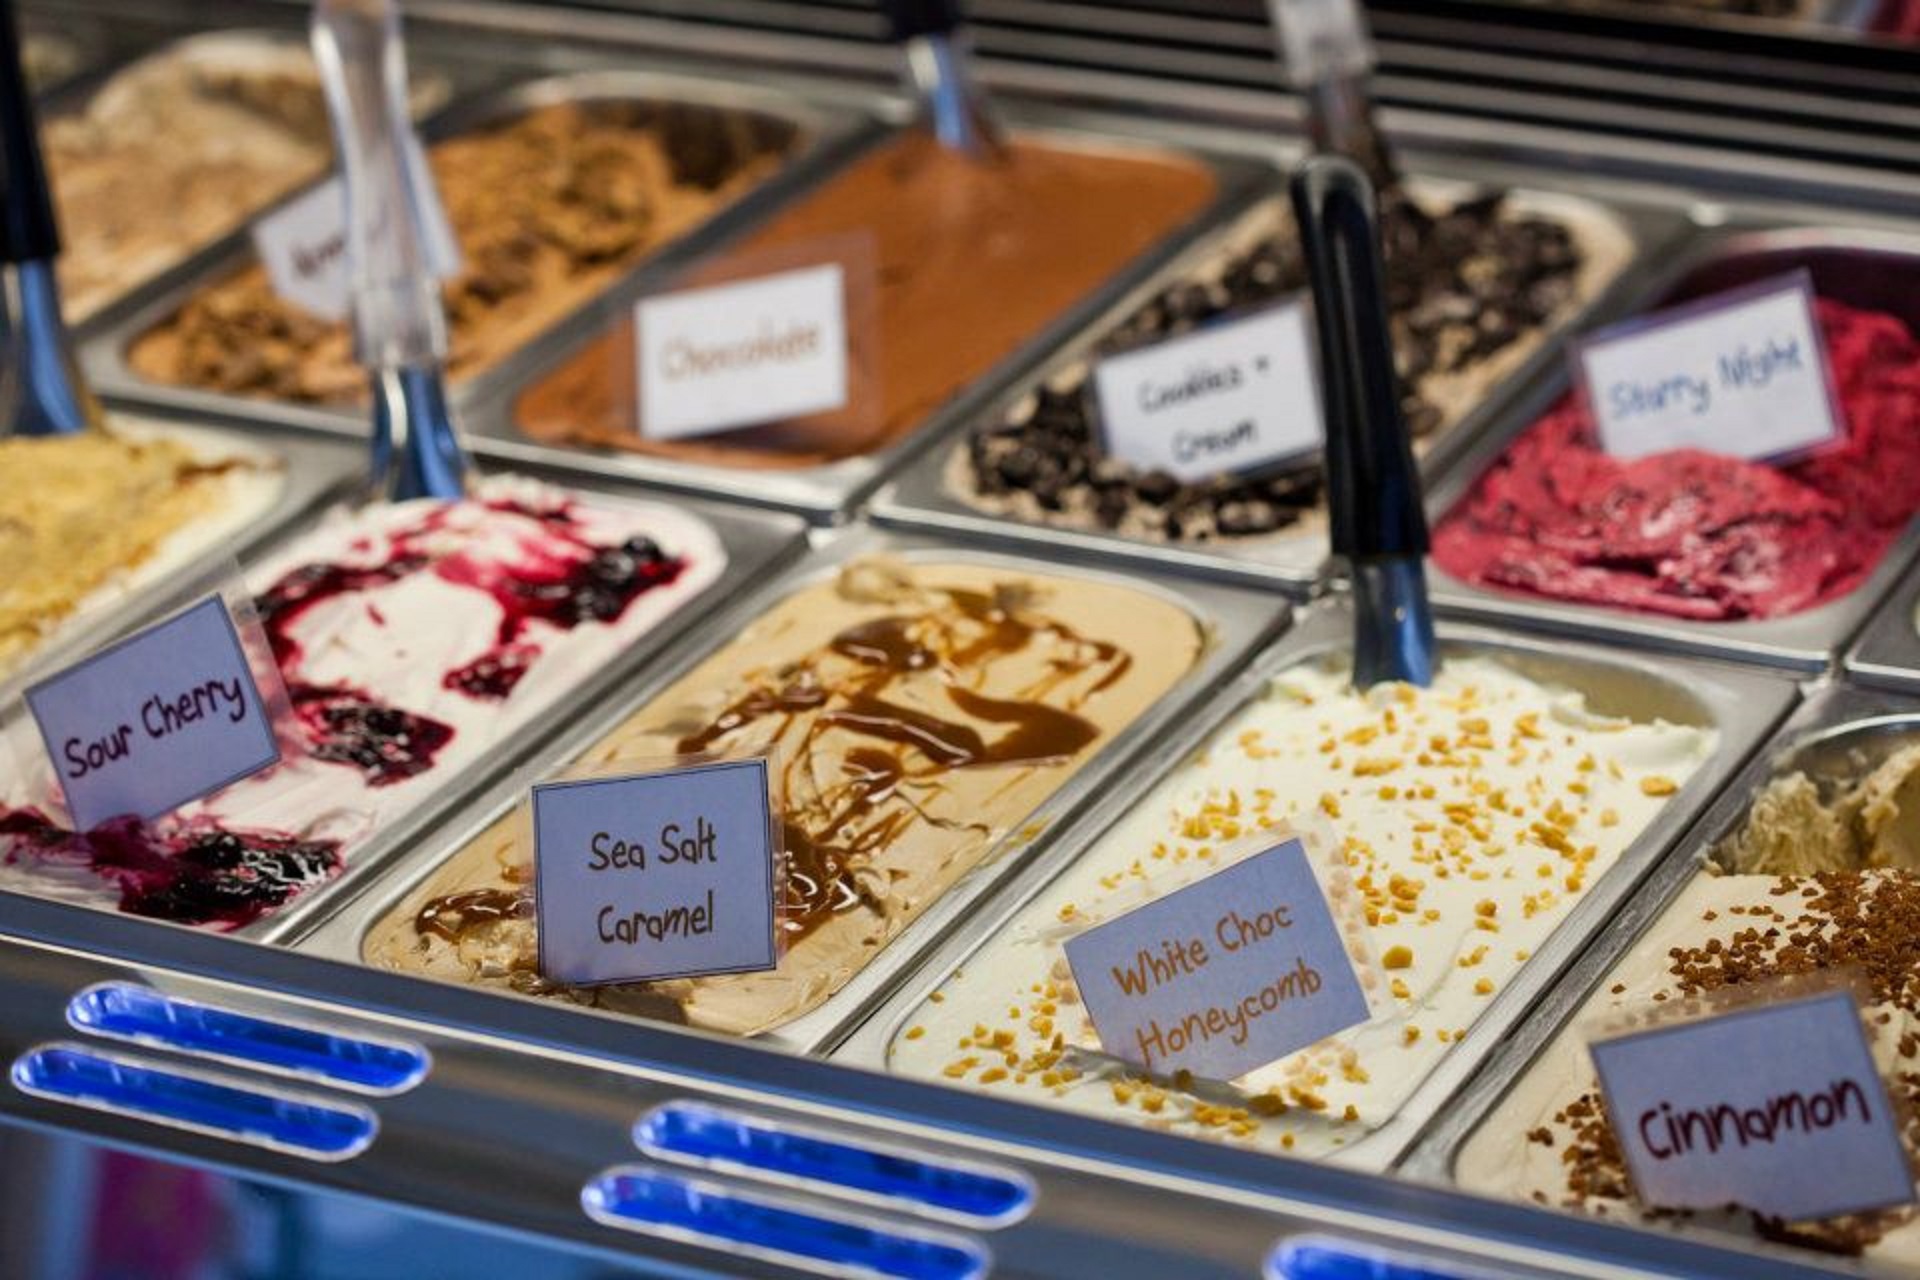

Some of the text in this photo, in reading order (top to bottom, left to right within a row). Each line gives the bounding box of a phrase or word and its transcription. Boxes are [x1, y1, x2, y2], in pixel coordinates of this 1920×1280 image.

[1138, 364, 1243, 413] Cookies
[1717, 339, 1802, 389] Night
[1173, 420, 1257, 463] Cream
[64, 678, 246, 778] Sour Cherry
[588, 816, 717, 871] Sea Salt
[597, 889, 714, 945] Caramel
[1111, 905, 1293, 996] White Choc
[1136, 957, 1322, 1066] Honeycomb
[1639, 1078, 1871, 1159] Cinnamon
